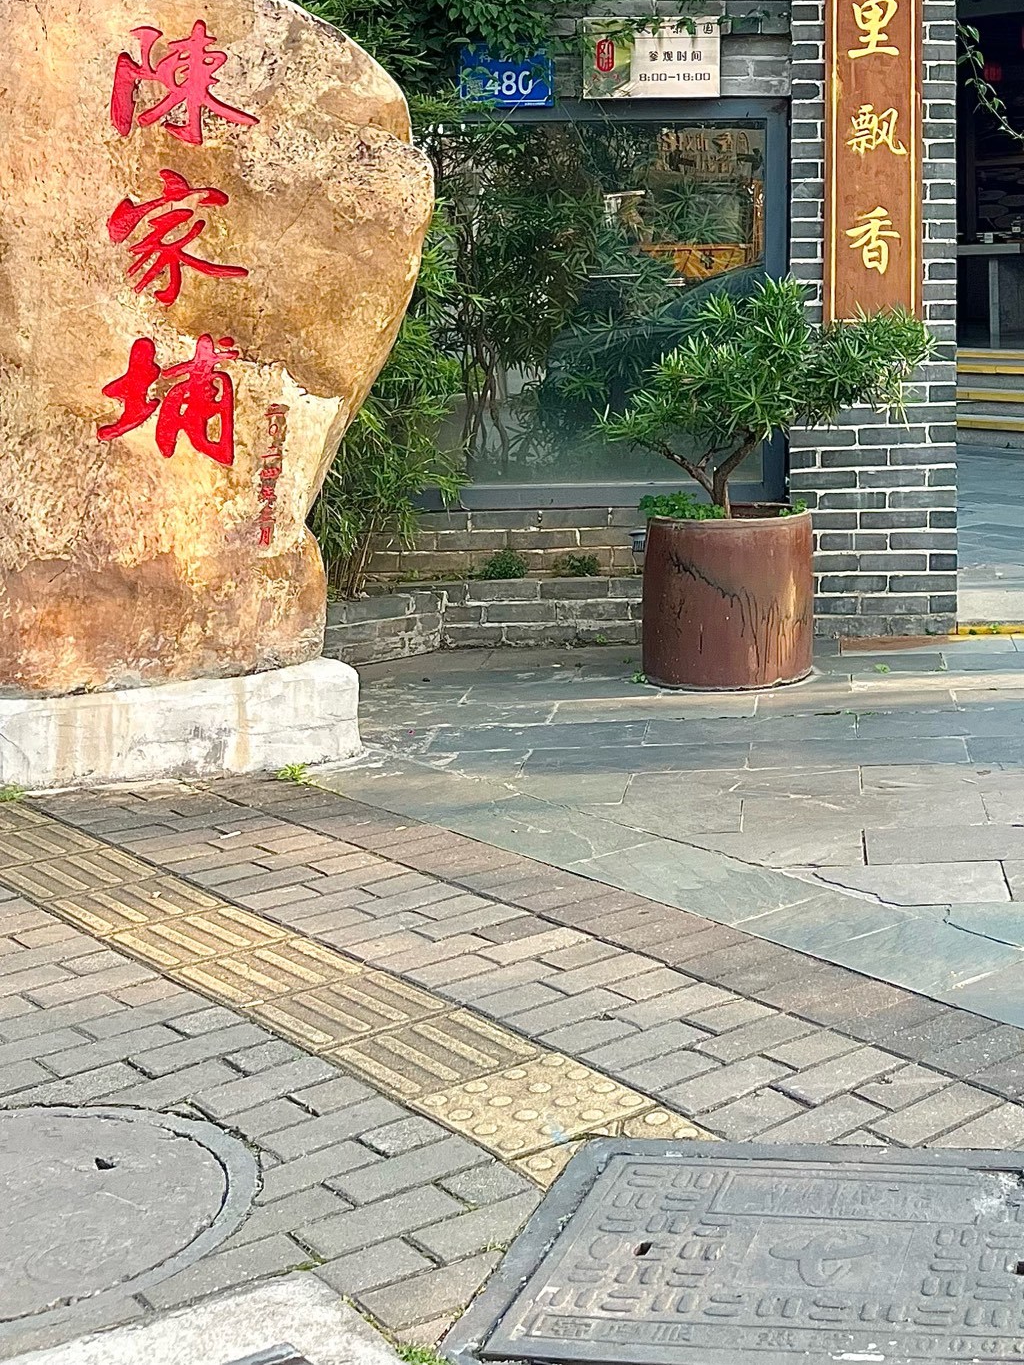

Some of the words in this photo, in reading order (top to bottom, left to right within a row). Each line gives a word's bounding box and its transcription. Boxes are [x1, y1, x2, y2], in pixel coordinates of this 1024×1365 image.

[649, 50, 702, 62] 参观时间
[486, 70, 533, 96] 480
[639, 72, 711, 82] 8:00-18:00
[96, 18, 260, 467] 陳家埔
